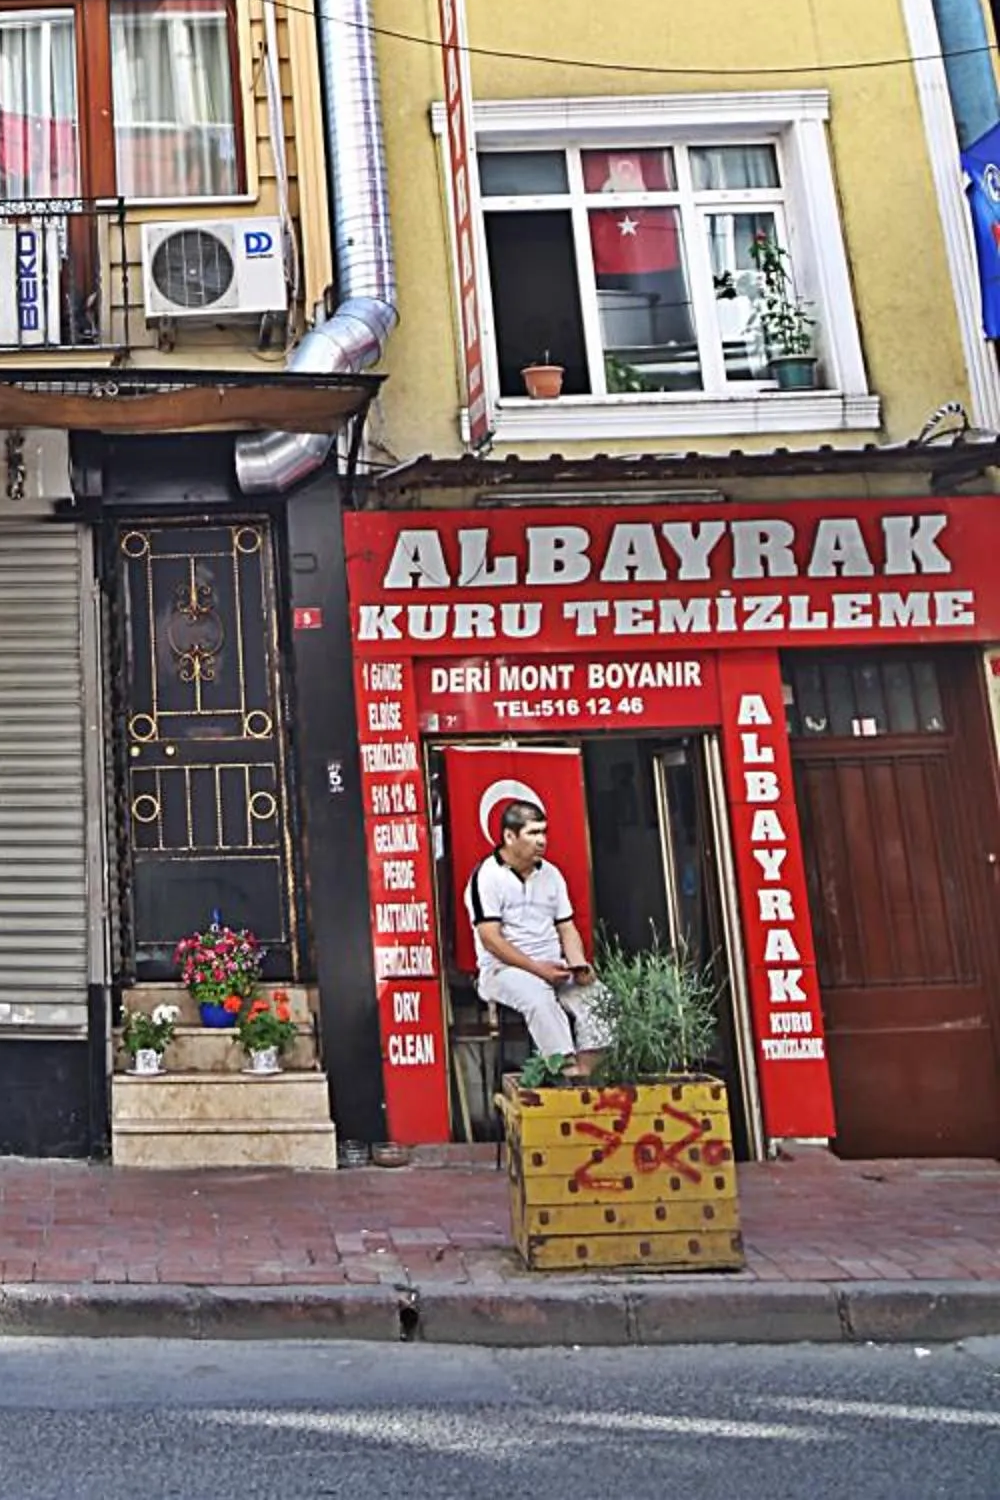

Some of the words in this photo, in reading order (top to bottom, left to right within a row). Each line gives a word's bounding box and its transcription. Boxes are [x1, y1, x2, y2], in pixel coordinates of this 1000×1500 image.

[18, 231, 39, 330] BEKO
[383, 515, 952, 589] ALBAYRAK
[357, 603, 542, 641] KURU
[563, 590, 975, 636] TEMİZLEME
[431, 661, 491, 693] DERİ
[499, 663, 574, 692] MONT
[587, 661, 701, 689] BOYANIR
[586, 699, 611, 715] 12
[617, 697, 643, 714] 46
[738, 694, 807, 1003] ALBAYRAK
[384, 859, 415, 890] PERDE
[393, 991, 420, 1023] DRY
[769, 1011, 813, 1033] KURU
[388, 1034, 435, 1066] CLEAN
